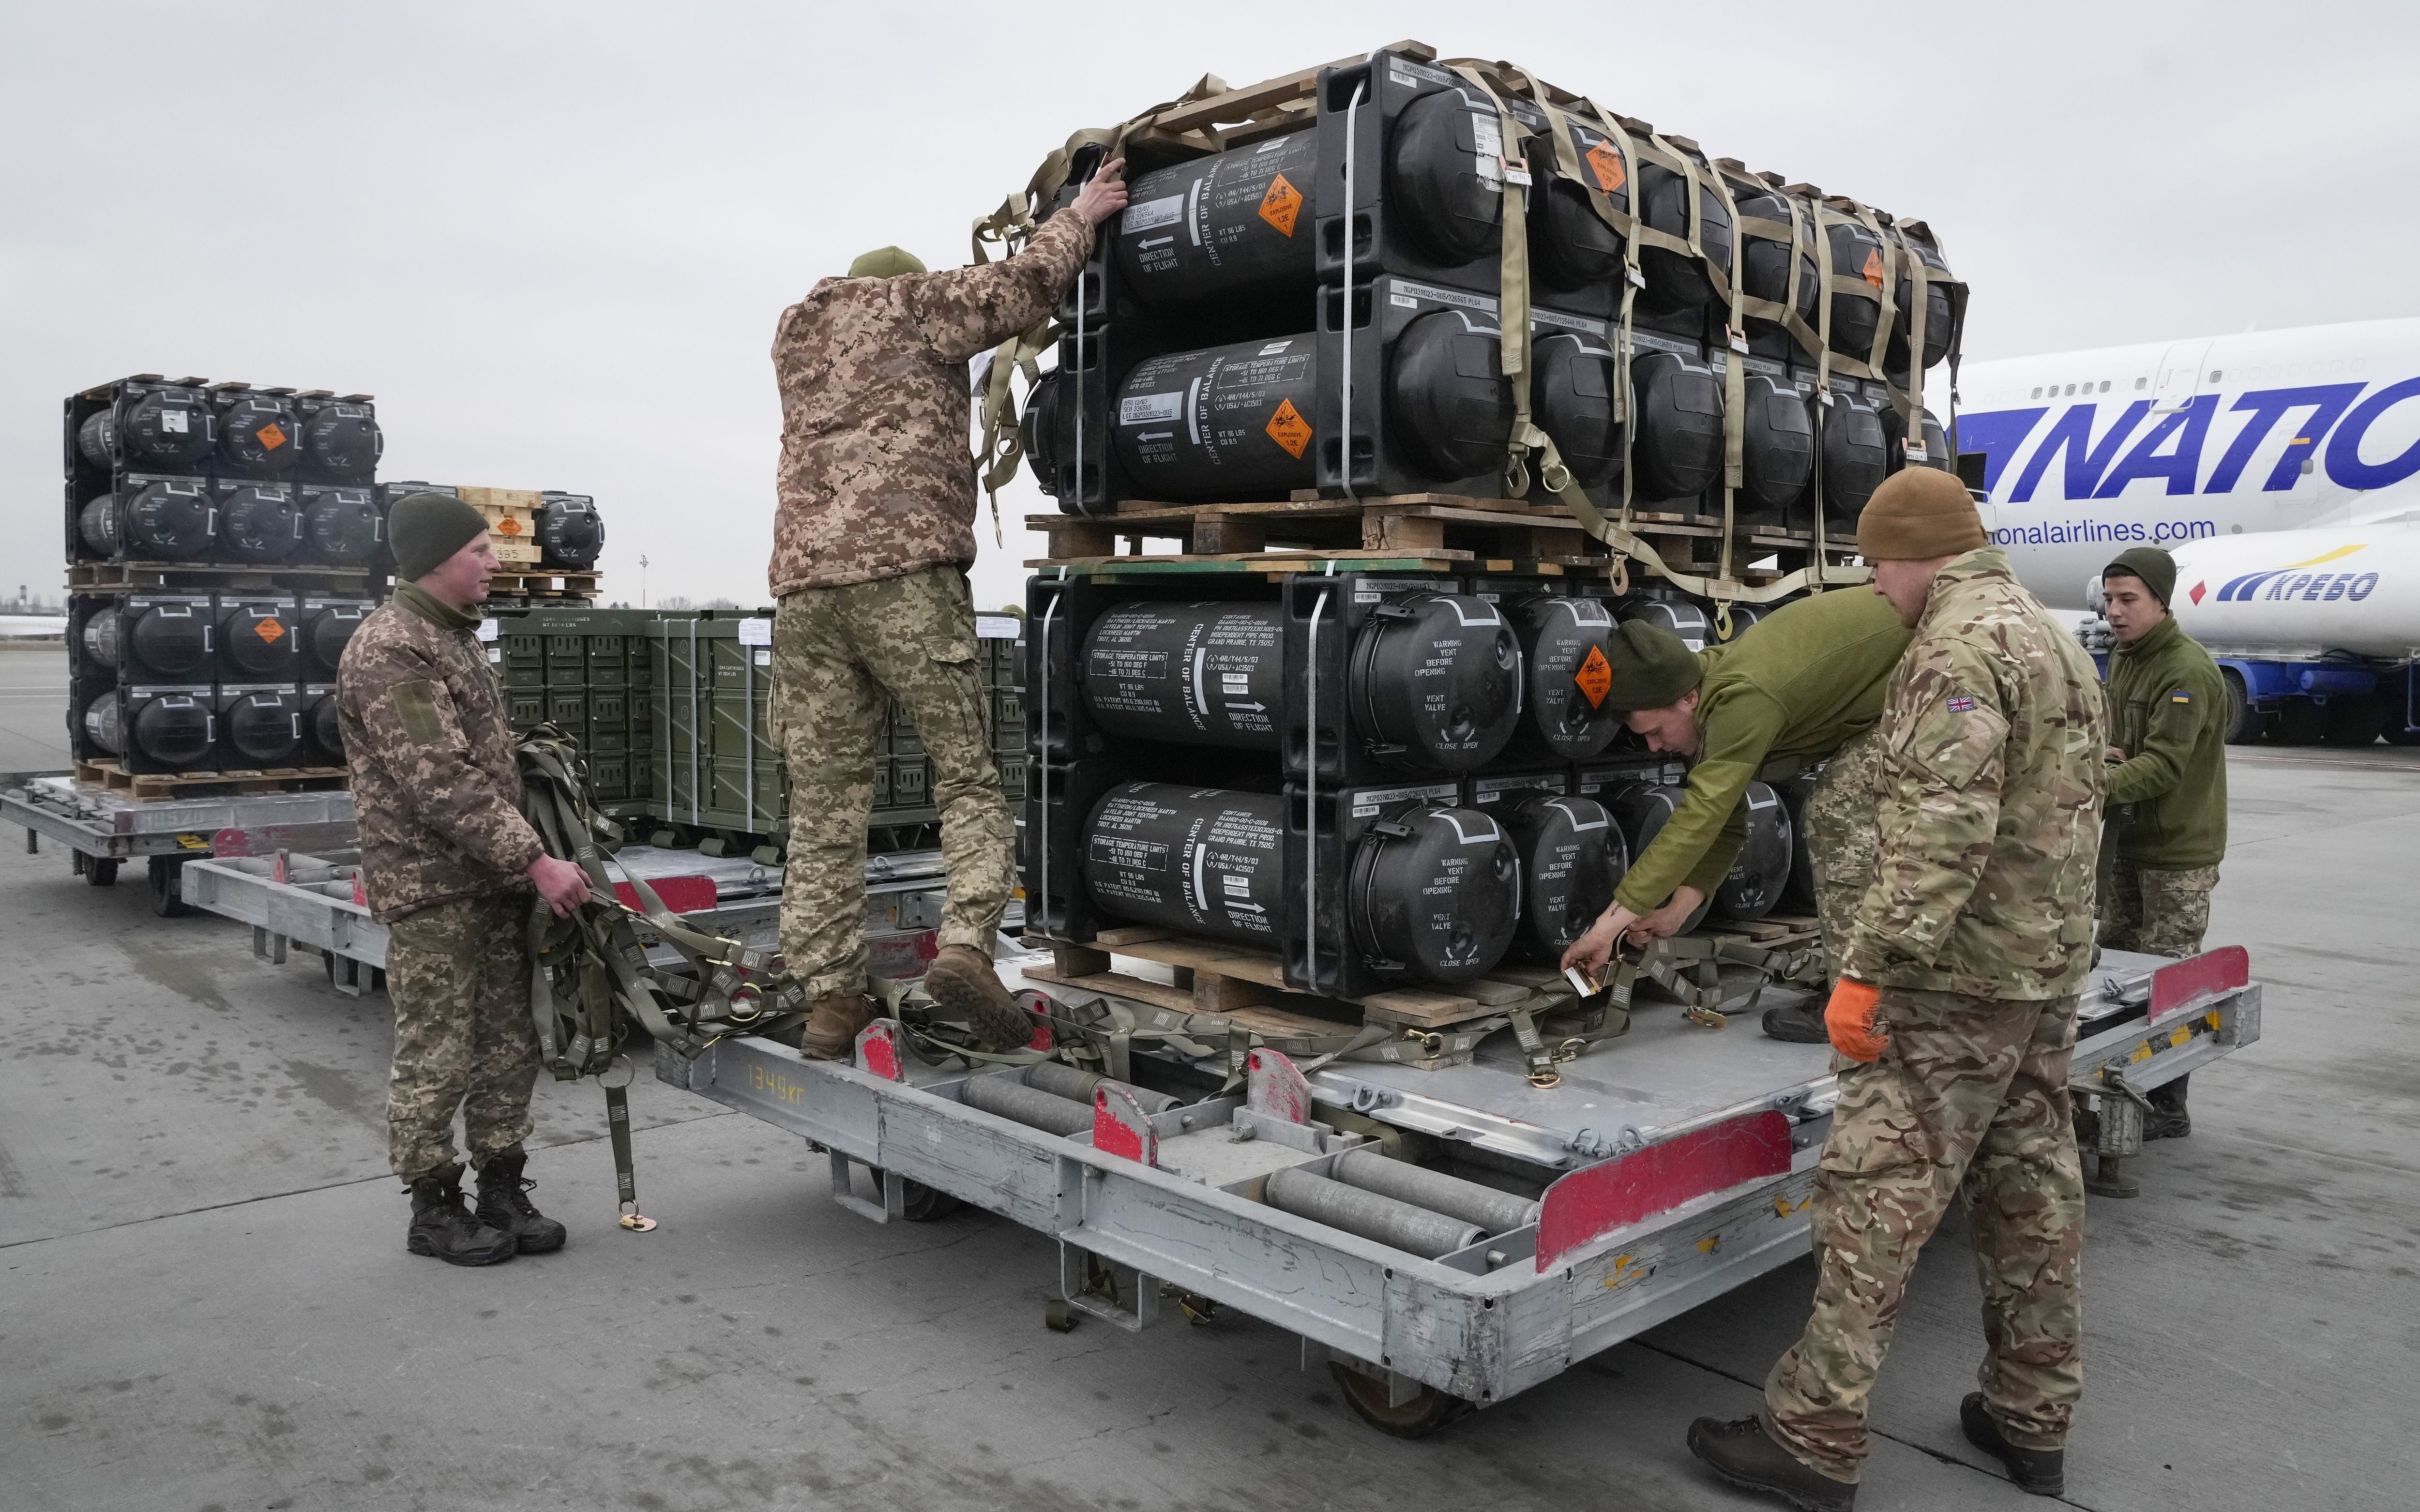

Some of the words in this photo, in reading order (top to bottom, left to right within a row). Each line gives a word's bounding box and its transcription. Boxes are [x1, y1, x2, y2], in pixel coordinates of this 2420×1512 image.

[1598, 163, 1617, 178] EXPLOSIVE
[1201, 157, 1226, 200] BALANCE
[1603, 173, 1612, 183] 1.2E
[1200, 205, 1208, 219] OF
[1270, 203, 1293, 216] EXPLOSIVE
[1278, 214, 1289, 223] 1.2E
[1201, 224, 1222, 266] CENTER
[1139, 247, 1175, 263] DIRECTION
[1143, 263, 1151, 272] OF
[1153, 258, 1178, 271] FLIGHT
[1200, 356, 1225, 400] BALANCE
[1200, 406, 1208, 420] OF
[1138, 442, 1174, 454] DIRECTION
[1201, 424, 1221, 465] CENTER
[1142, 455, 1151, 464] OF
[1153, 453, 1177, 463] FLIGHT
[2263, 573, 2378, 601] КРЕБО
[1183, 623, 1204, 662] CENTER
[1433, 639, 1462, 648] WARNING
[1426, 658, 1453, 667] BEFORE
[1182, 667, 1190, 681] OF
[1415, 667, 1446, 677] OPENING
[1182, 686, 1207, 730] BALANCE
[1107, 802, 1158, 813] RAYTHEON/LOCKHEED
[1100, 814, 1123, 822] LOCKHEED
[1183, 818, 1204, 858] CENTER
[1210, 828, 1245, 838] INDEPENDENT
[1094, 838, 1115, 847] STORAGE
[1116, 840, 1149, 852] TEMPERATURE
[1150, 845, 1165, 853] LIMITS
[1257, 841, 1275, 849] 75052
[1555, 844, 1580, 853] WARNING
[1441, 858, 1468, 866] WARNING
[1549, 862, 1573, 871] BEFORE
[1182, 862, 1190, 877] OF
[1448, 867, 1464, 876] VENT
[1434, 876, 1460, 885] BEFORE
[1539, 871, 1566, 880] OPENING
[1106, 889, 1124, 897] PATENT
[1422, 886, 1452, 895] OPENING
[1182, 881, 1206, 925] BALANCE
[1549, 895, 1565, 904] VENT
[1548, 904, 1566, 912] VALVE
[1227, 910, 1269, 924] DIRECTION
[1244, 922, 1272, 933] FLIGHT
[1465, 957, 1480, 966] OPEN
